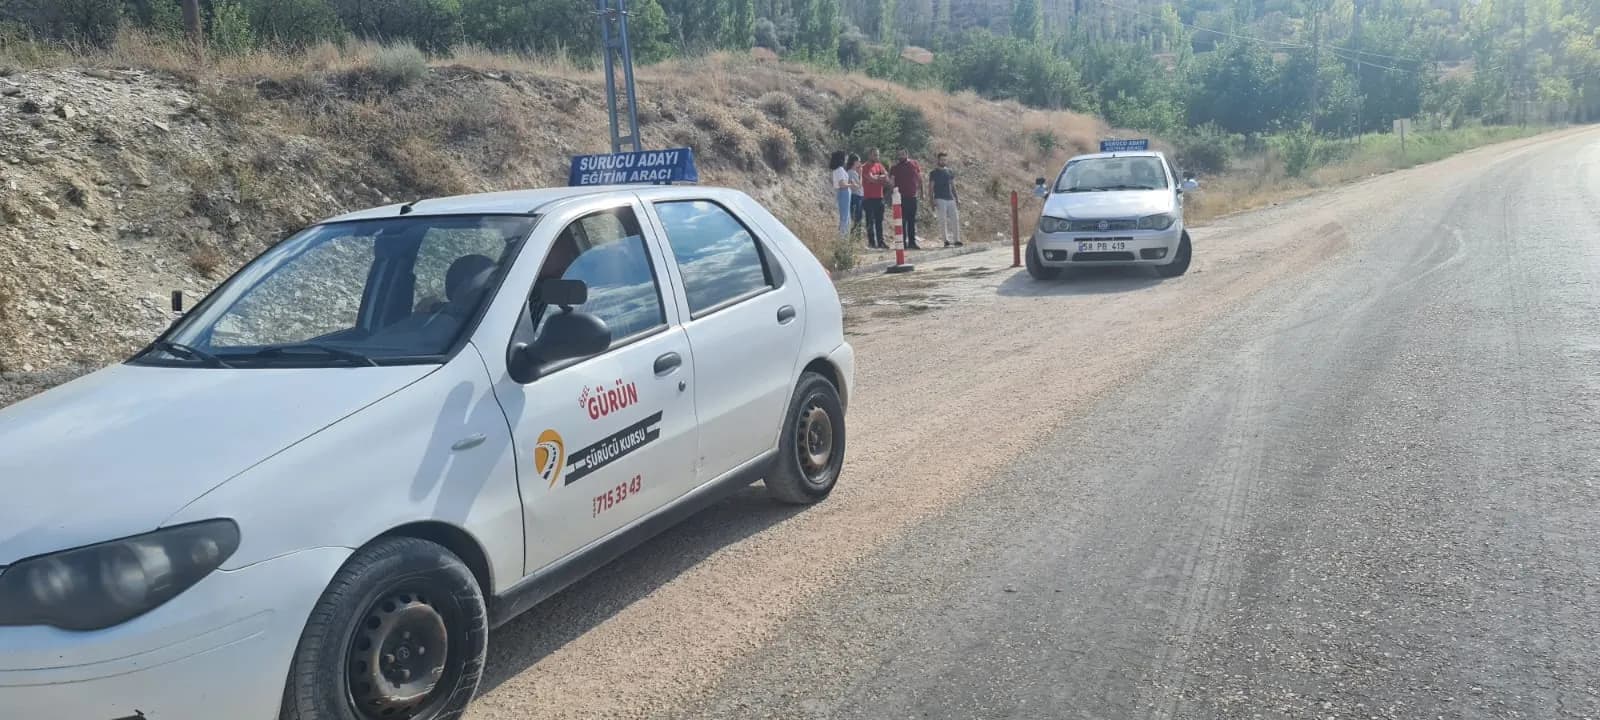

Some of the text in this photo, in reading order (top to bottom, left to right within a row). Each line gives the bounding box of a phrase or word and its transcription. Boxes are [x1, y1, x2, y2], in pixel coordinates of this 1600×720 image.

[581, 168, 671, 185] EĞİTİM ARACI
[638, 151, 678, 167] ADAYI
[588, 378, 637, 420] GÜRÜN
[585, 427, 645, 469] SÜRÜCÜ KURSU
[596, 489, 613, 514] 715
[615, 482, 627, 504] 33
[630, 474, 641, 495] 43
